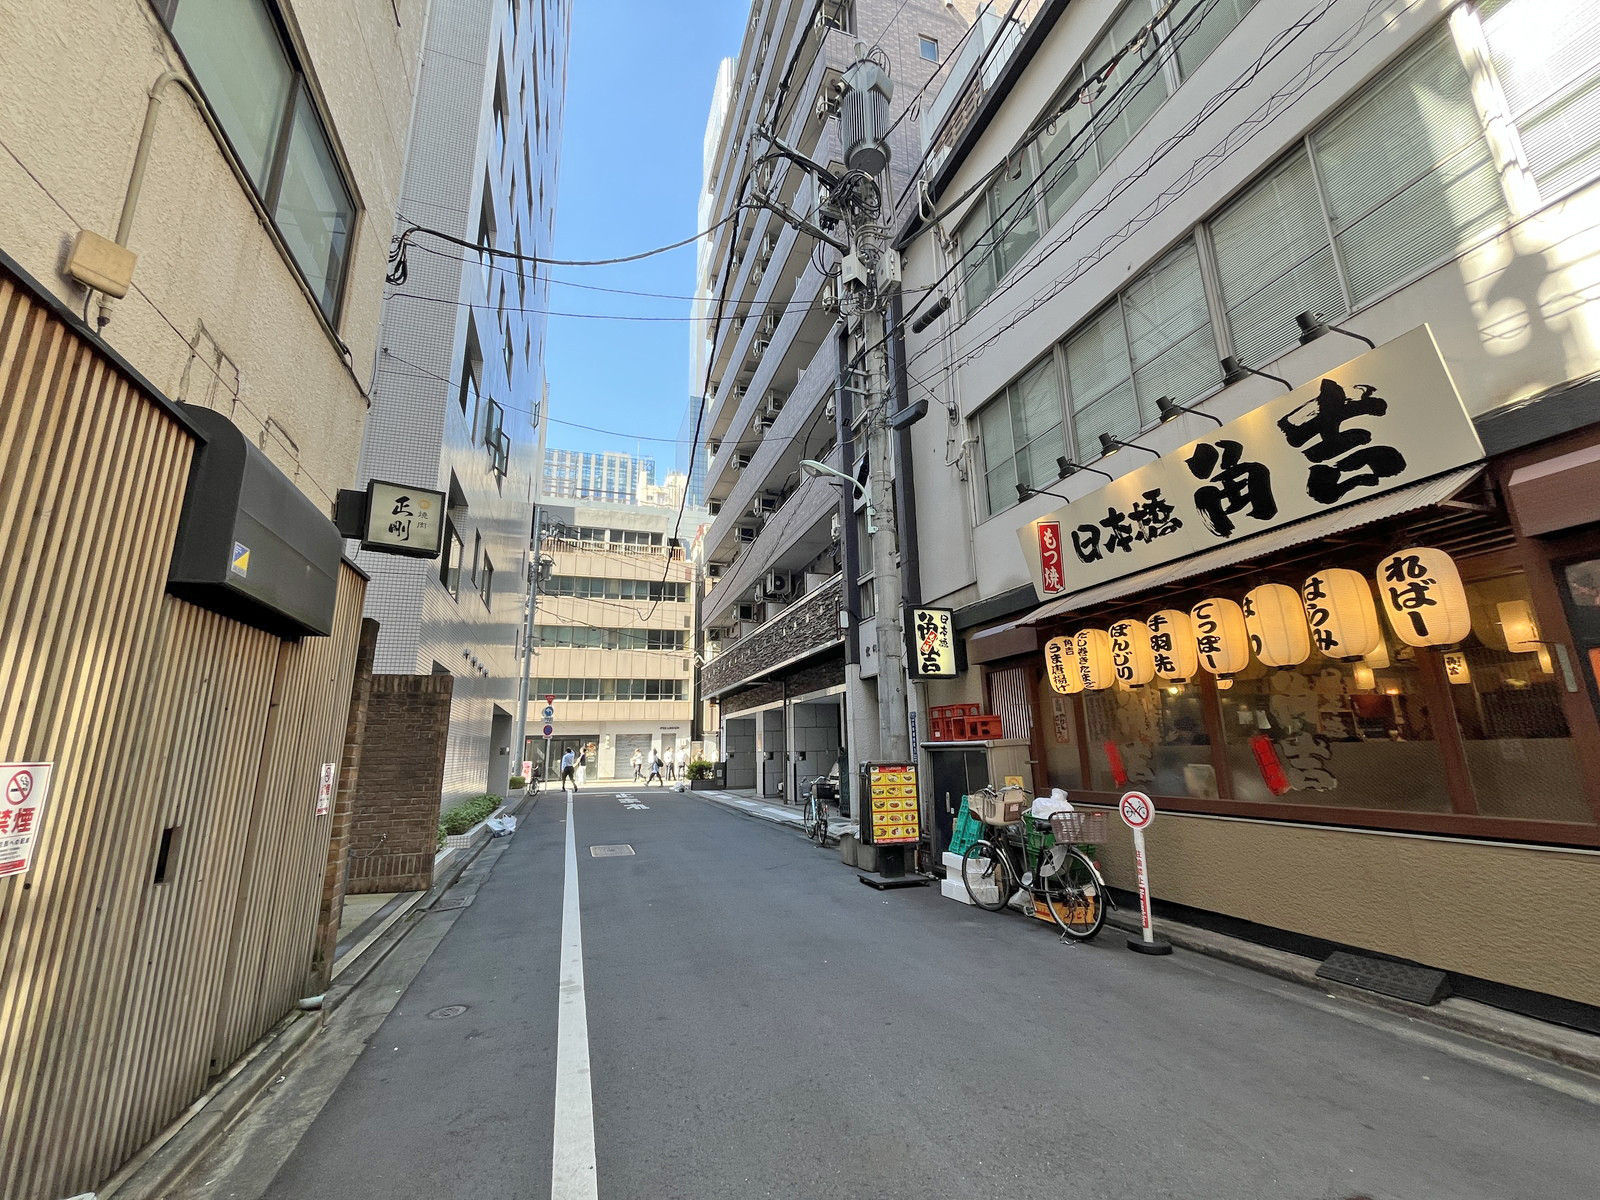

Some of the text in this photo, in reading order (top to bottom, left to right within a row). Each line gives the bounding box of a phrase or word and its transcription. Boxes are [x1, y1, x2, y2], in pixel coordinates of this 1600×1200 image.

[1071, 378, 1407, 563] 日本橋 角吉
[388, 496, 413, 541] 正剛
[1042, 527, 1062, 590] もつ焼
[1147, 614, 1175, 673] 手羽先
